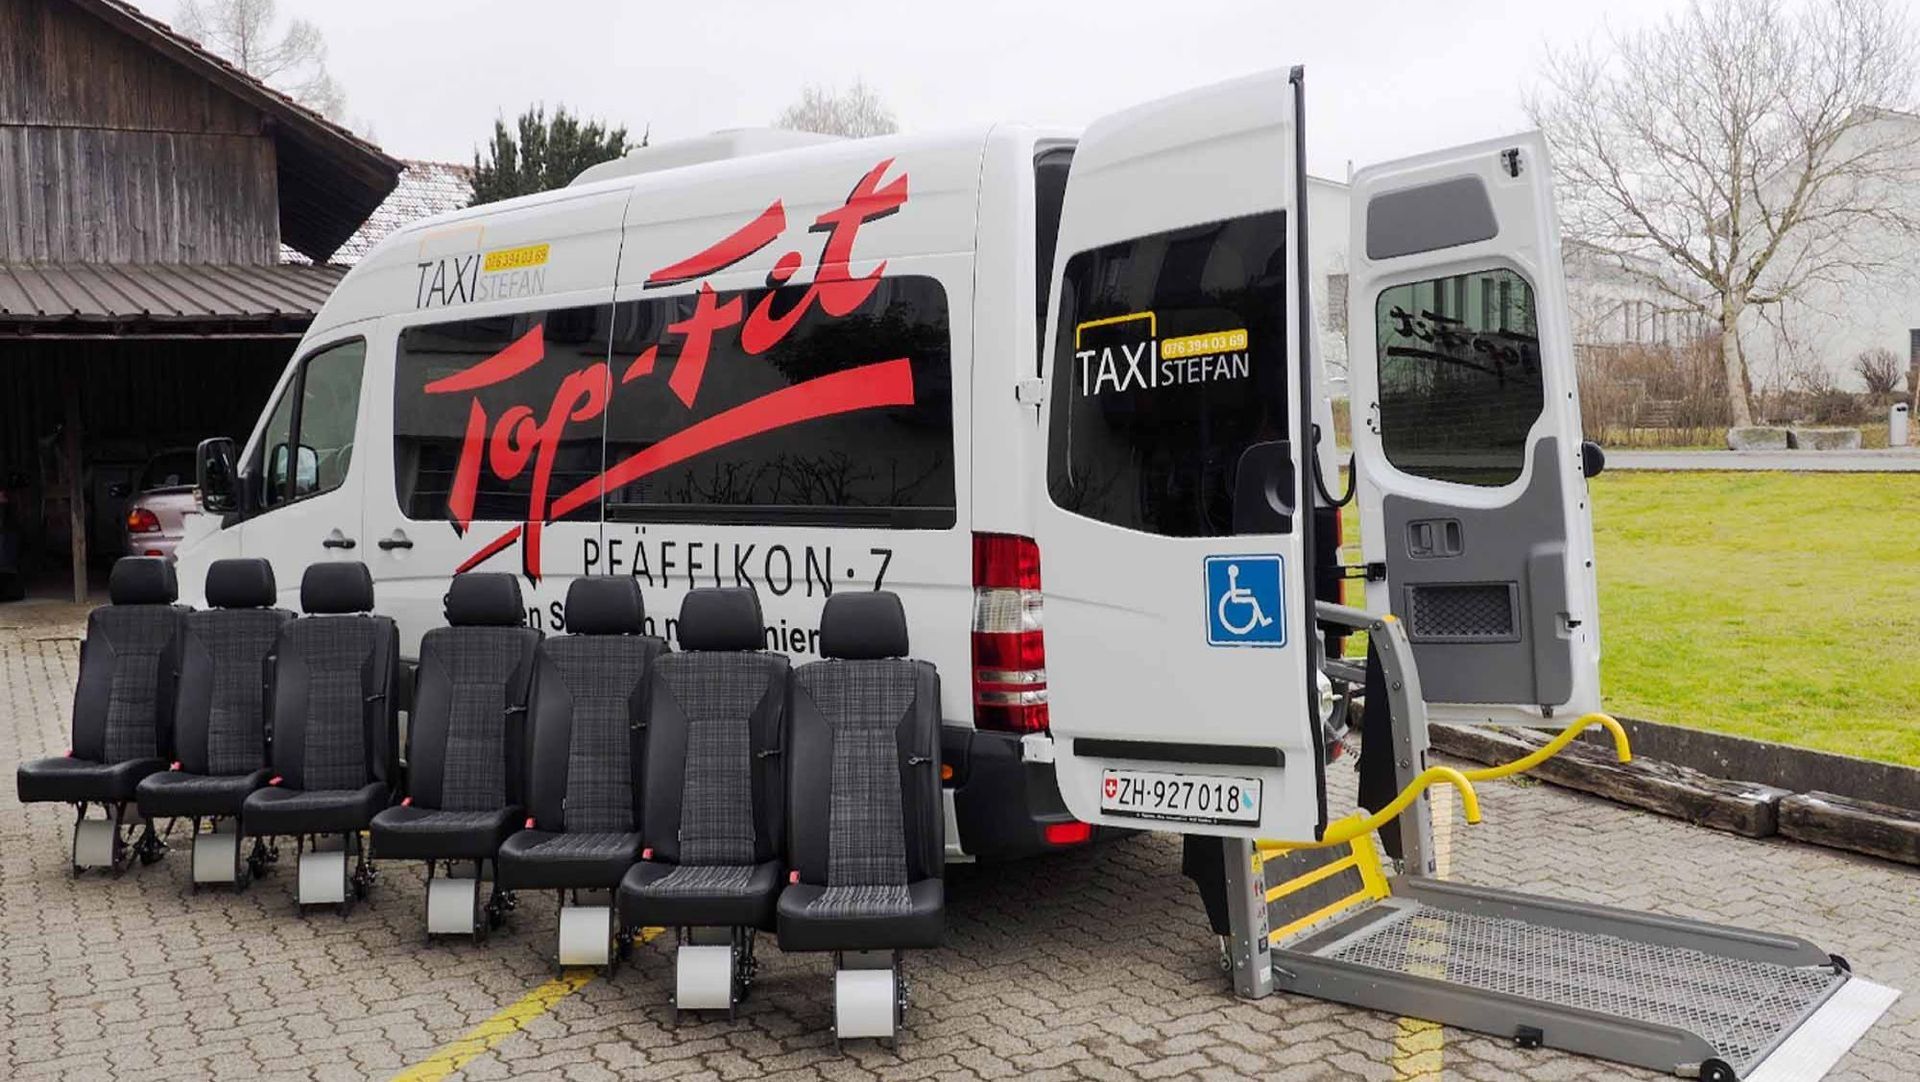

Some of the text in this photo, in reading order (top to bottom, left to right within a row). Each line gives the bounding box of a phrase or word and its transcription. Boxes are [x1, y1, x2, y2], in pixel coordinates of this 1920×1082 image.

[417, 254, 481, 308] TAXI
[481, 269, 547, 299] STEFAN
[1164, 333, 1245, 355] 076 394 03 69
[1076, 340, 1157, 396] TAXI
[1161, 352, 1249, 386] STEFAN
[584, 526, 833, 598] PFÄFFIKON
